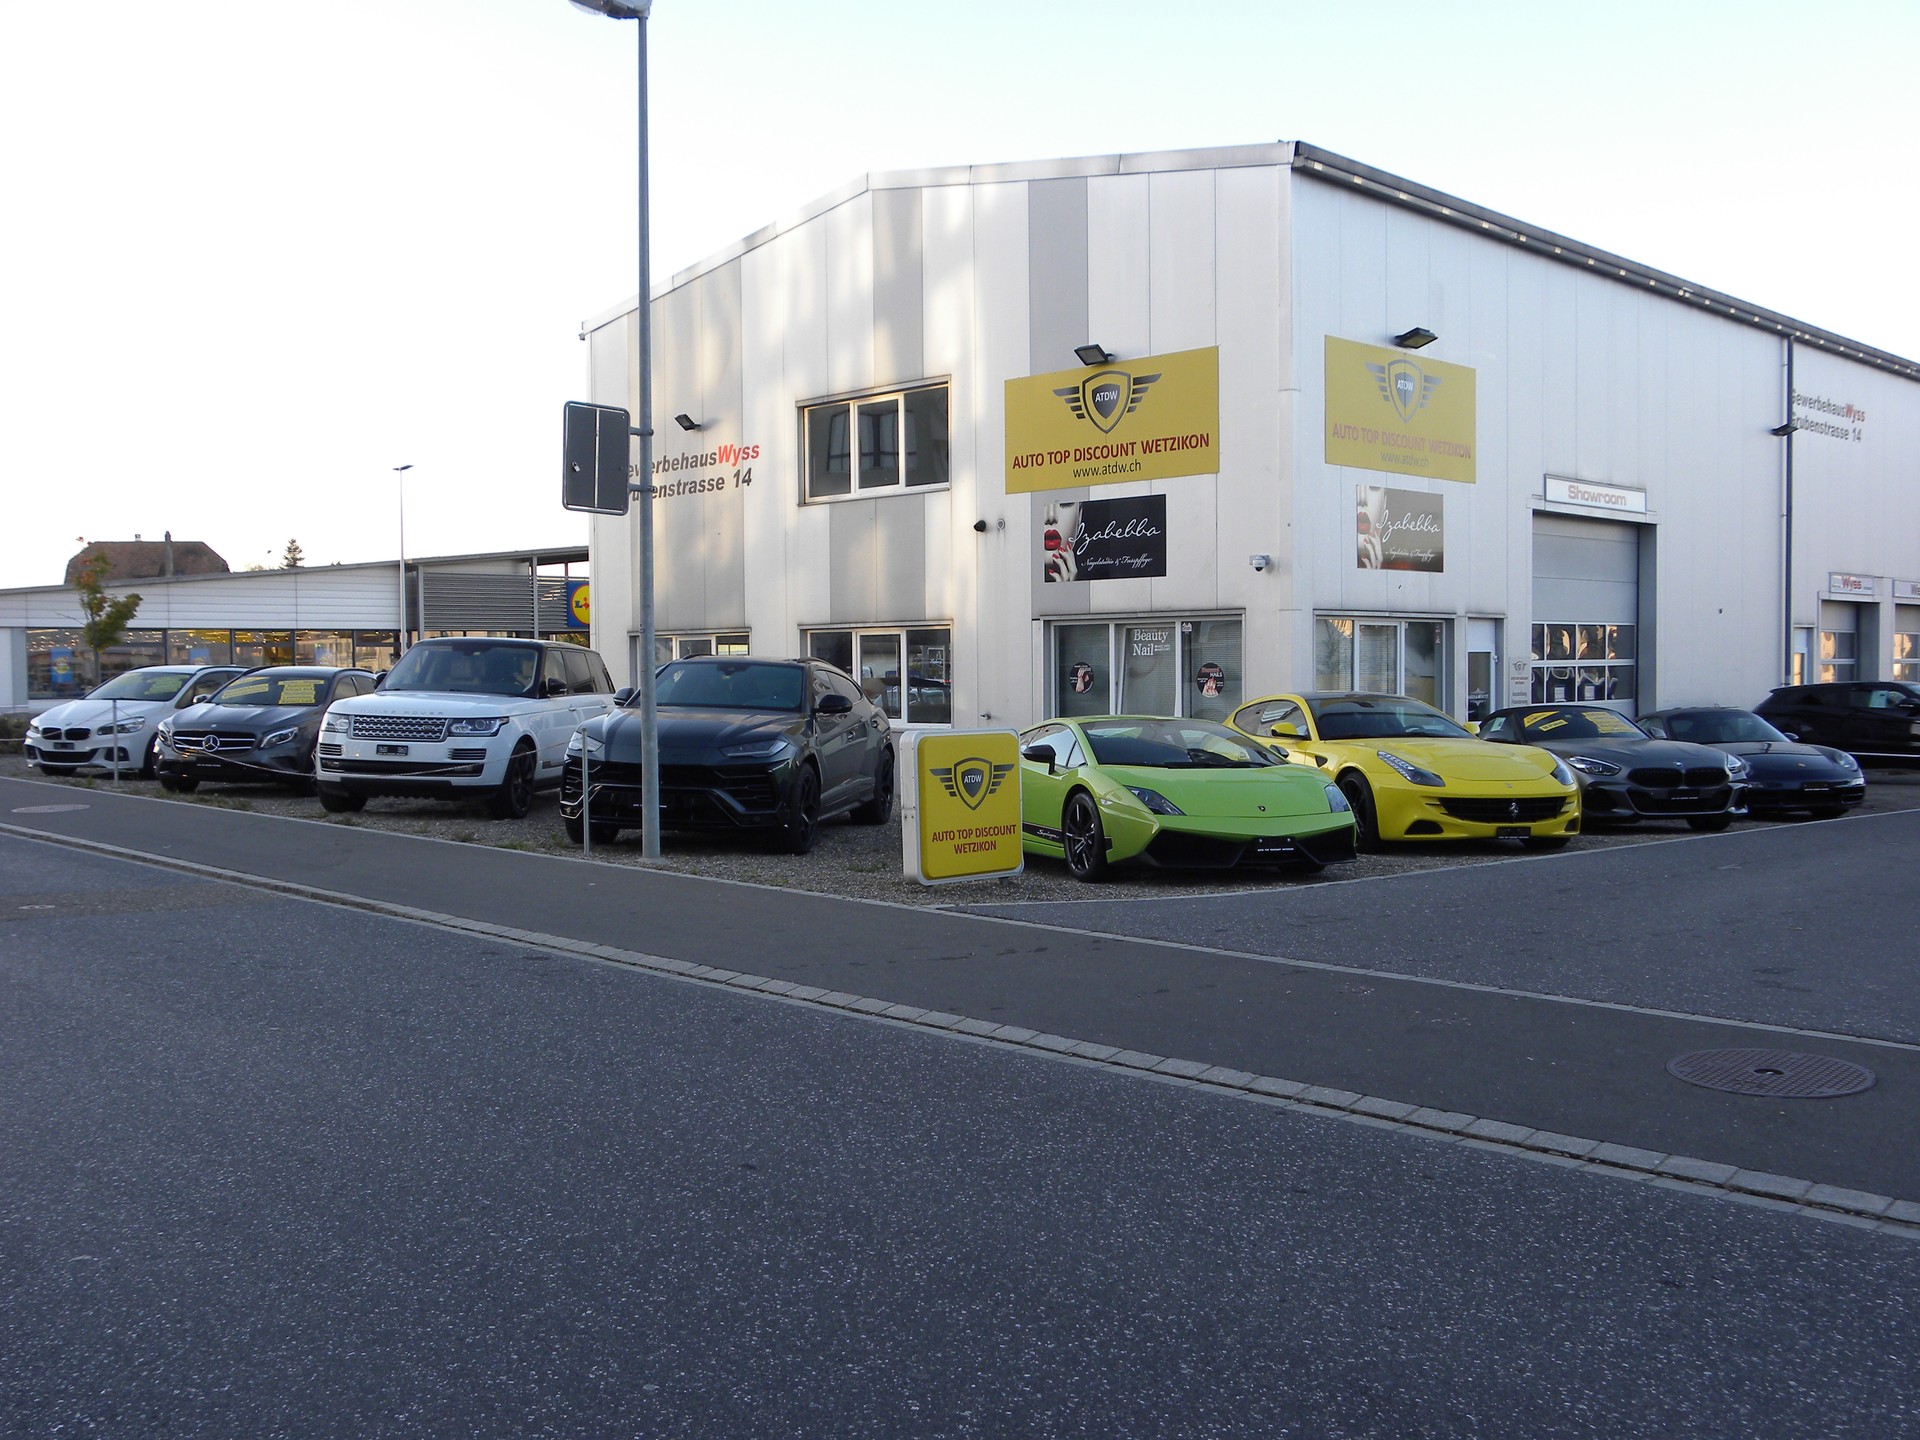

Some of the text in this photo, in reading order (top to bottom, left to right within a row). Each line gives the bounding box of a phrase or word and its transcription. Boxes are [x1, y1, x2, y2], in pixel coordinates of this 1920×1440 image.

[1396, 379, 1414, 391] ATDW
[1095, 390, 1118, 402] ATDW
[1332, 423, 1359, 441] AUTO
[1361, 428, 1379, 445] TOP
[1381, 431, 1425, 452] DISCOUNT
[1852, 427, 1862, 443] 14
[1012, 432, 1210, 469] AUTO TOP DISCOUNT WETZIKON
[1072, 459, 1142, 478] www.atdw.ch
[732, 467, 752, 489] 14
[1567, 484, 1627, 507] Showroom
[1841, 575, 1862, 592] Wyss
[1132, 643, 1155, 656] Nail
[963, 774, 983, 784] ATDW
[931, 824, 1017, 843] AUTO TOP DISCOUNT
[953, 840, 997, 855] WETZIKON
